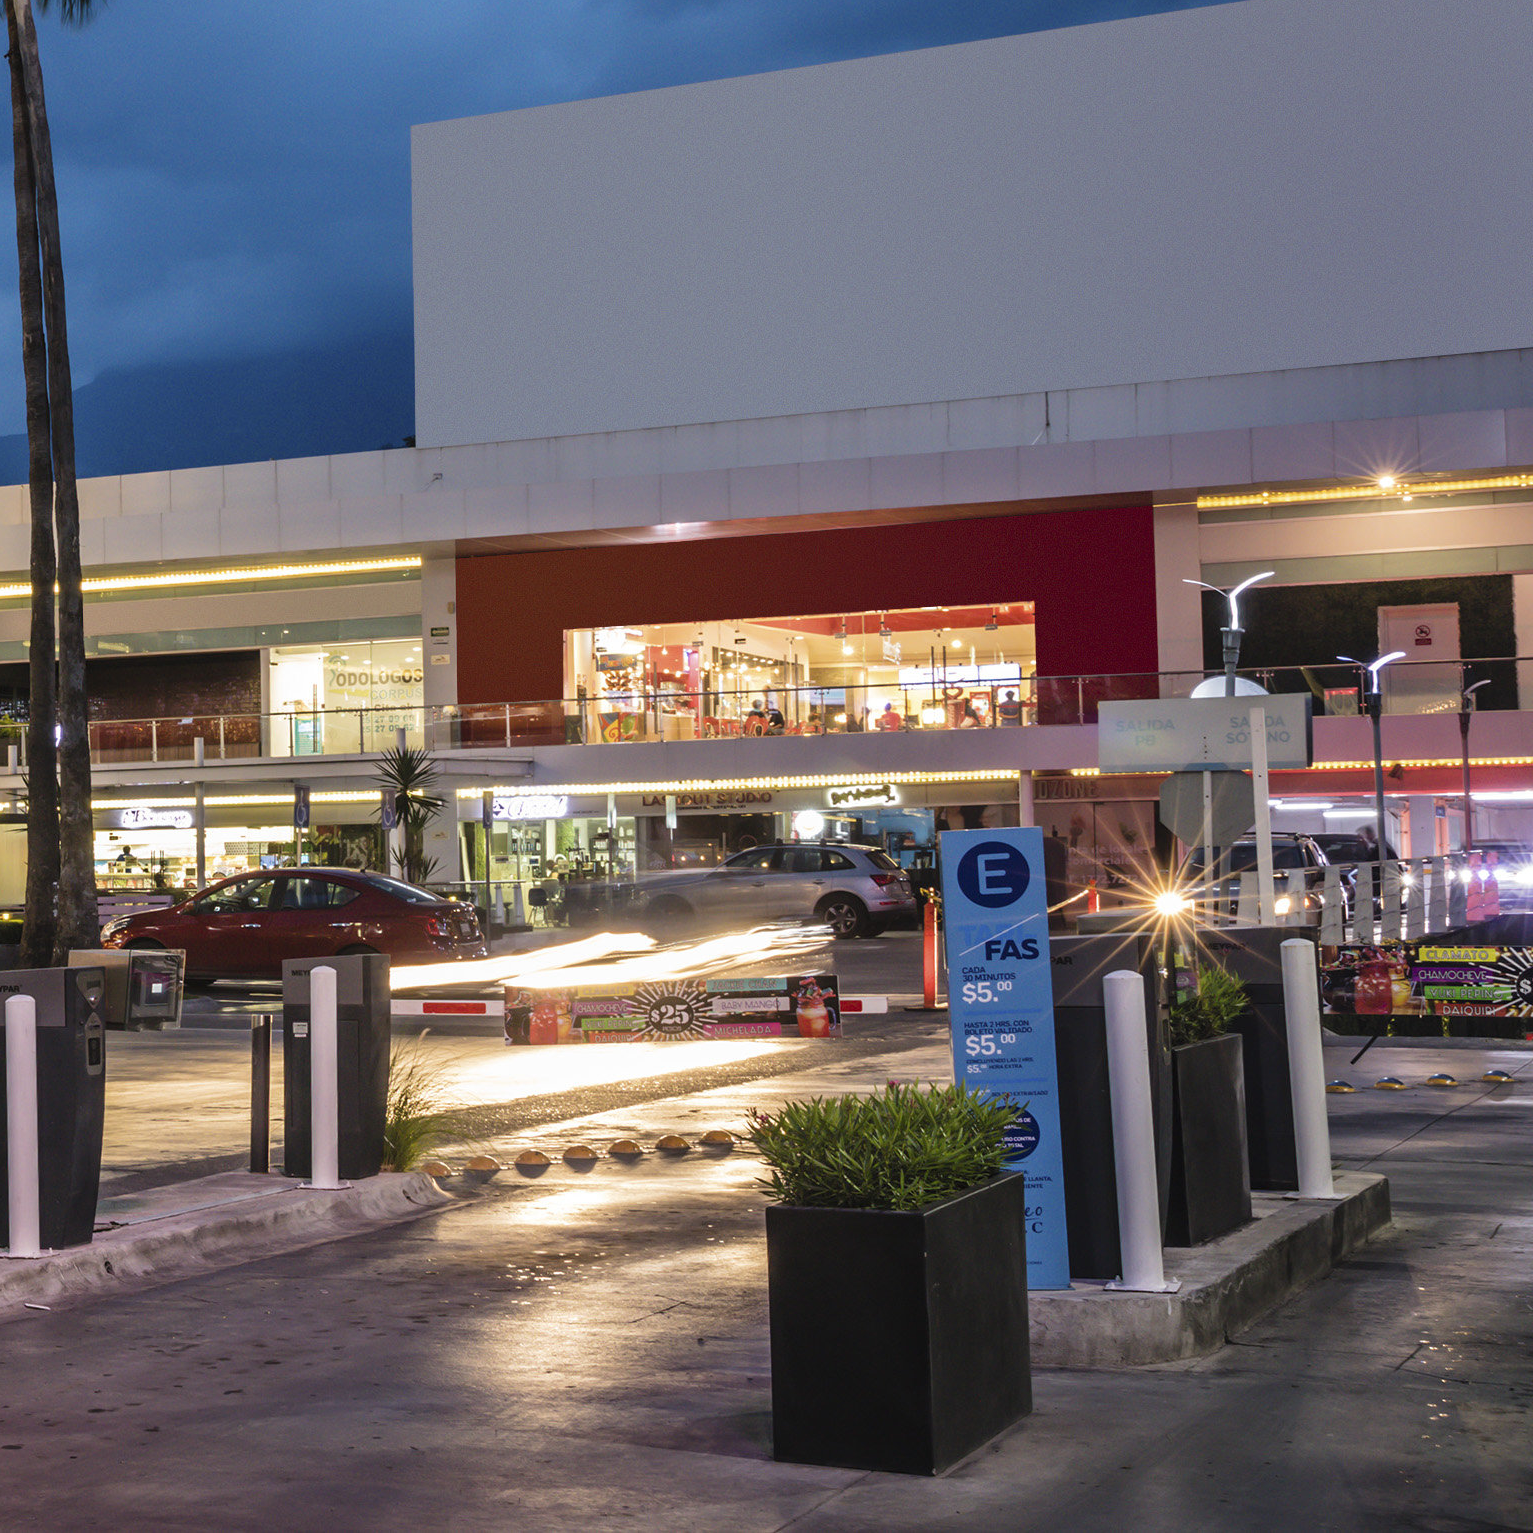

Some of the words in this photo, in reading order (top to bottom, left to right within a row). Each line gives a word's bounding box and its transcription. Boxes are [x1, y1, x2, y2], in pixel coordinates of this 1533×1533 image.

[1116, 718, 1175, 732] SALIDA
[1230, 715, 1285, 729] SADA
[1226, 730, 1291, 744] SÓNO
[716, 792, 772, 804] STUDIO
[977, 853, 1013, 895] E
[985, 939, 1040, 961] FAS
[1426, 949, 1489, 960] CLAMATO
[962, 967, 986, 975] CADA
[1418, 969, 1487, 980] CHAMOCHEVE
[963, 974, 973, 982] 30
[975, 973, 1016, 981] MINUTOS
[712, 980, 745, 990] JACKIE
[748, 979, 777, 989] CHAN
[1429, 988, 1456, 999] YUKI
[1460, 988, 1504, 999] PEPINO
[721, 1001, 743, 1010] BABY
[745, 999, 781, 1009] MANGO
[650, 1004, 690, 1026] $25
[714, 1025, 771, 1035] MICHELADA
